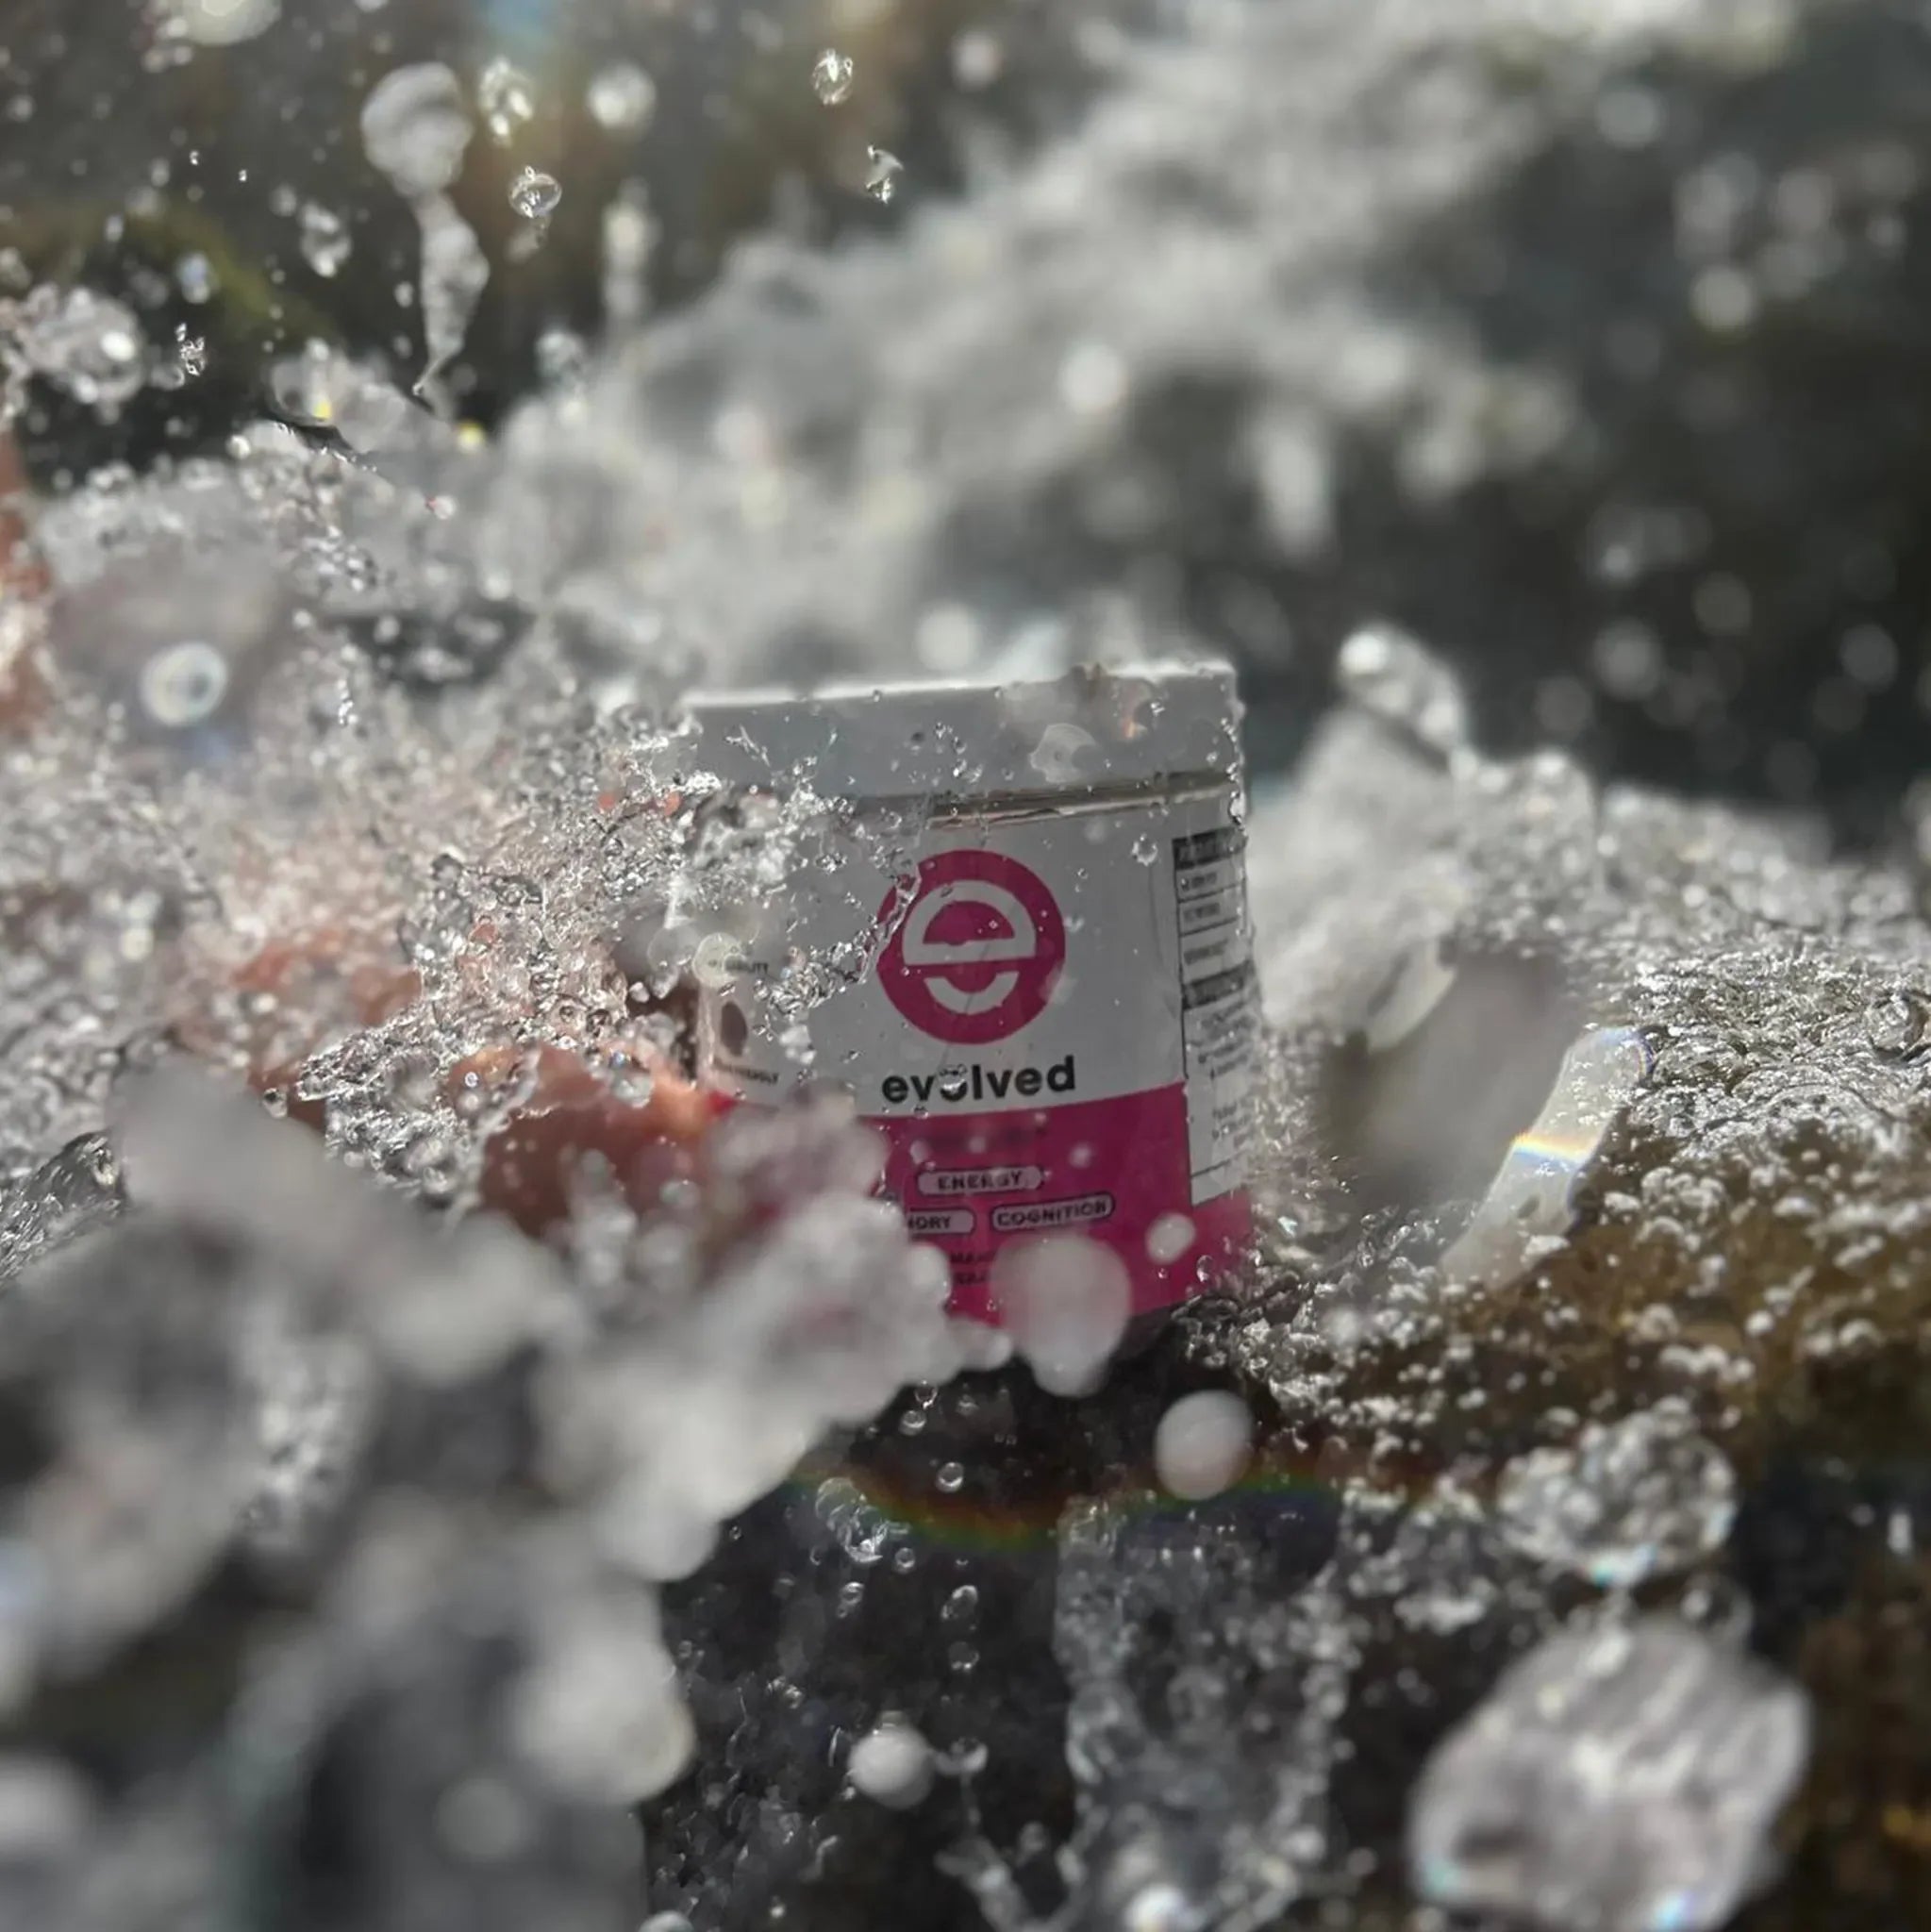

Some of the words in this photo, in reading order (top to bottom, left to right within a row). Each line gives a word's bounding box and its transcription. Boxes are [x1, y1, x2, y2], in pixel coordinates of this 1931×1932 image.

[881, 1055, 1075, 1104] evolved
[937, 1171, 1023, 1191] ENERGY
[996, 1200, 1107, 1226] COGNITION
